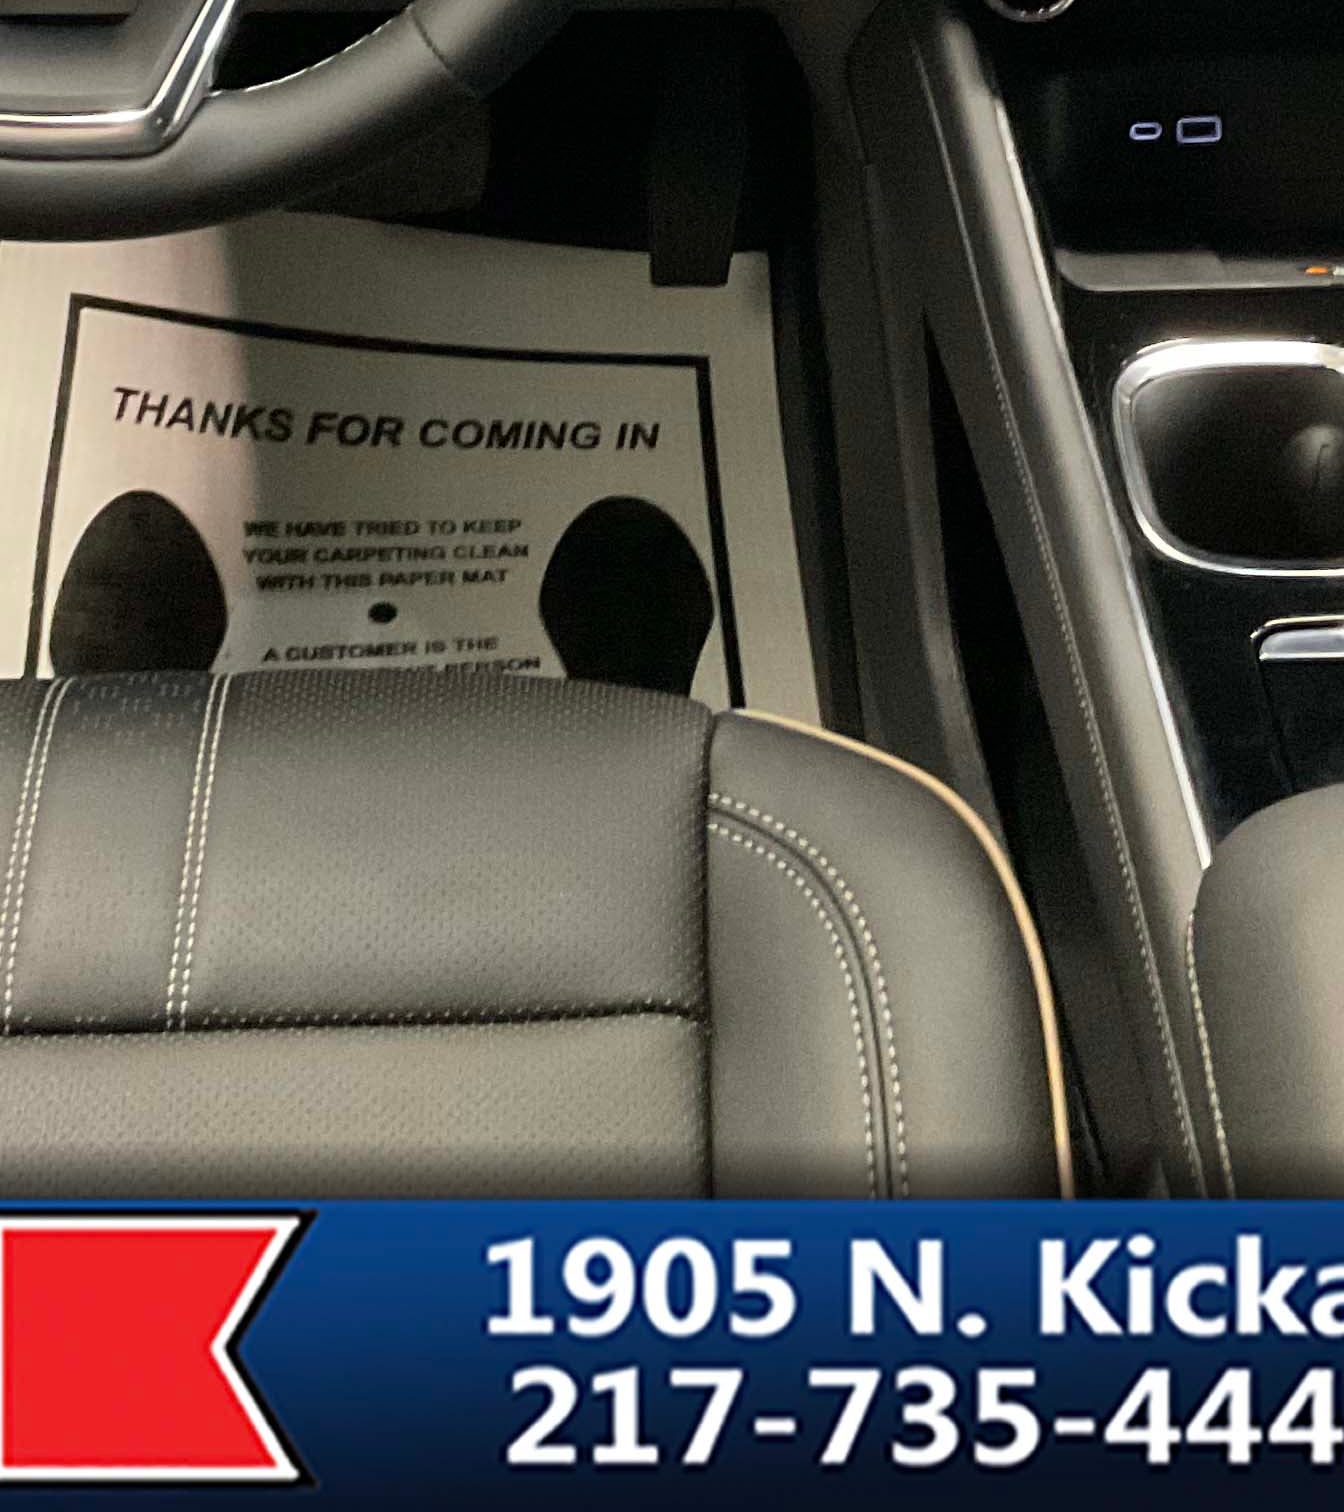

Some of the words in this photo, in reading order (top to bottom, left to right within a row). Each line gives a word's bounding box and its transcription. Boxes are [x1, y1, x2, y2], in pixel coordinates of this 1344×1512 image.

[112, 386, 294, 445] THANKS
[305, 411, 406, 448] FOR
[418, 418, 602, 451] COMING
[614, 422, 661, 452] IN
[243, 521, 279, 538] WE
[286, 520, 347, 537] HAVE
[355, 519, 420, 536] TRIED
[428, 519, 456, 535] TO
[463, 518, 522, 535] KEEP
[242, 548, 308, 565] YOUR
[312, 546, 446, 564] CARPETING
[453, 544, 530, 560] CLEAN
[256, 574, 315, 592] WITH
[323, 572, 372, 589] THIS
[379, 569, 455, 587] PAPER
[461, 568, 509, 584] MAT
[262, 647, 279, 663] A
[285, 642, 418, 662] CUSTOMER
[424, 640, 446, 655] IS
[456, 638, 500, 652] THE
